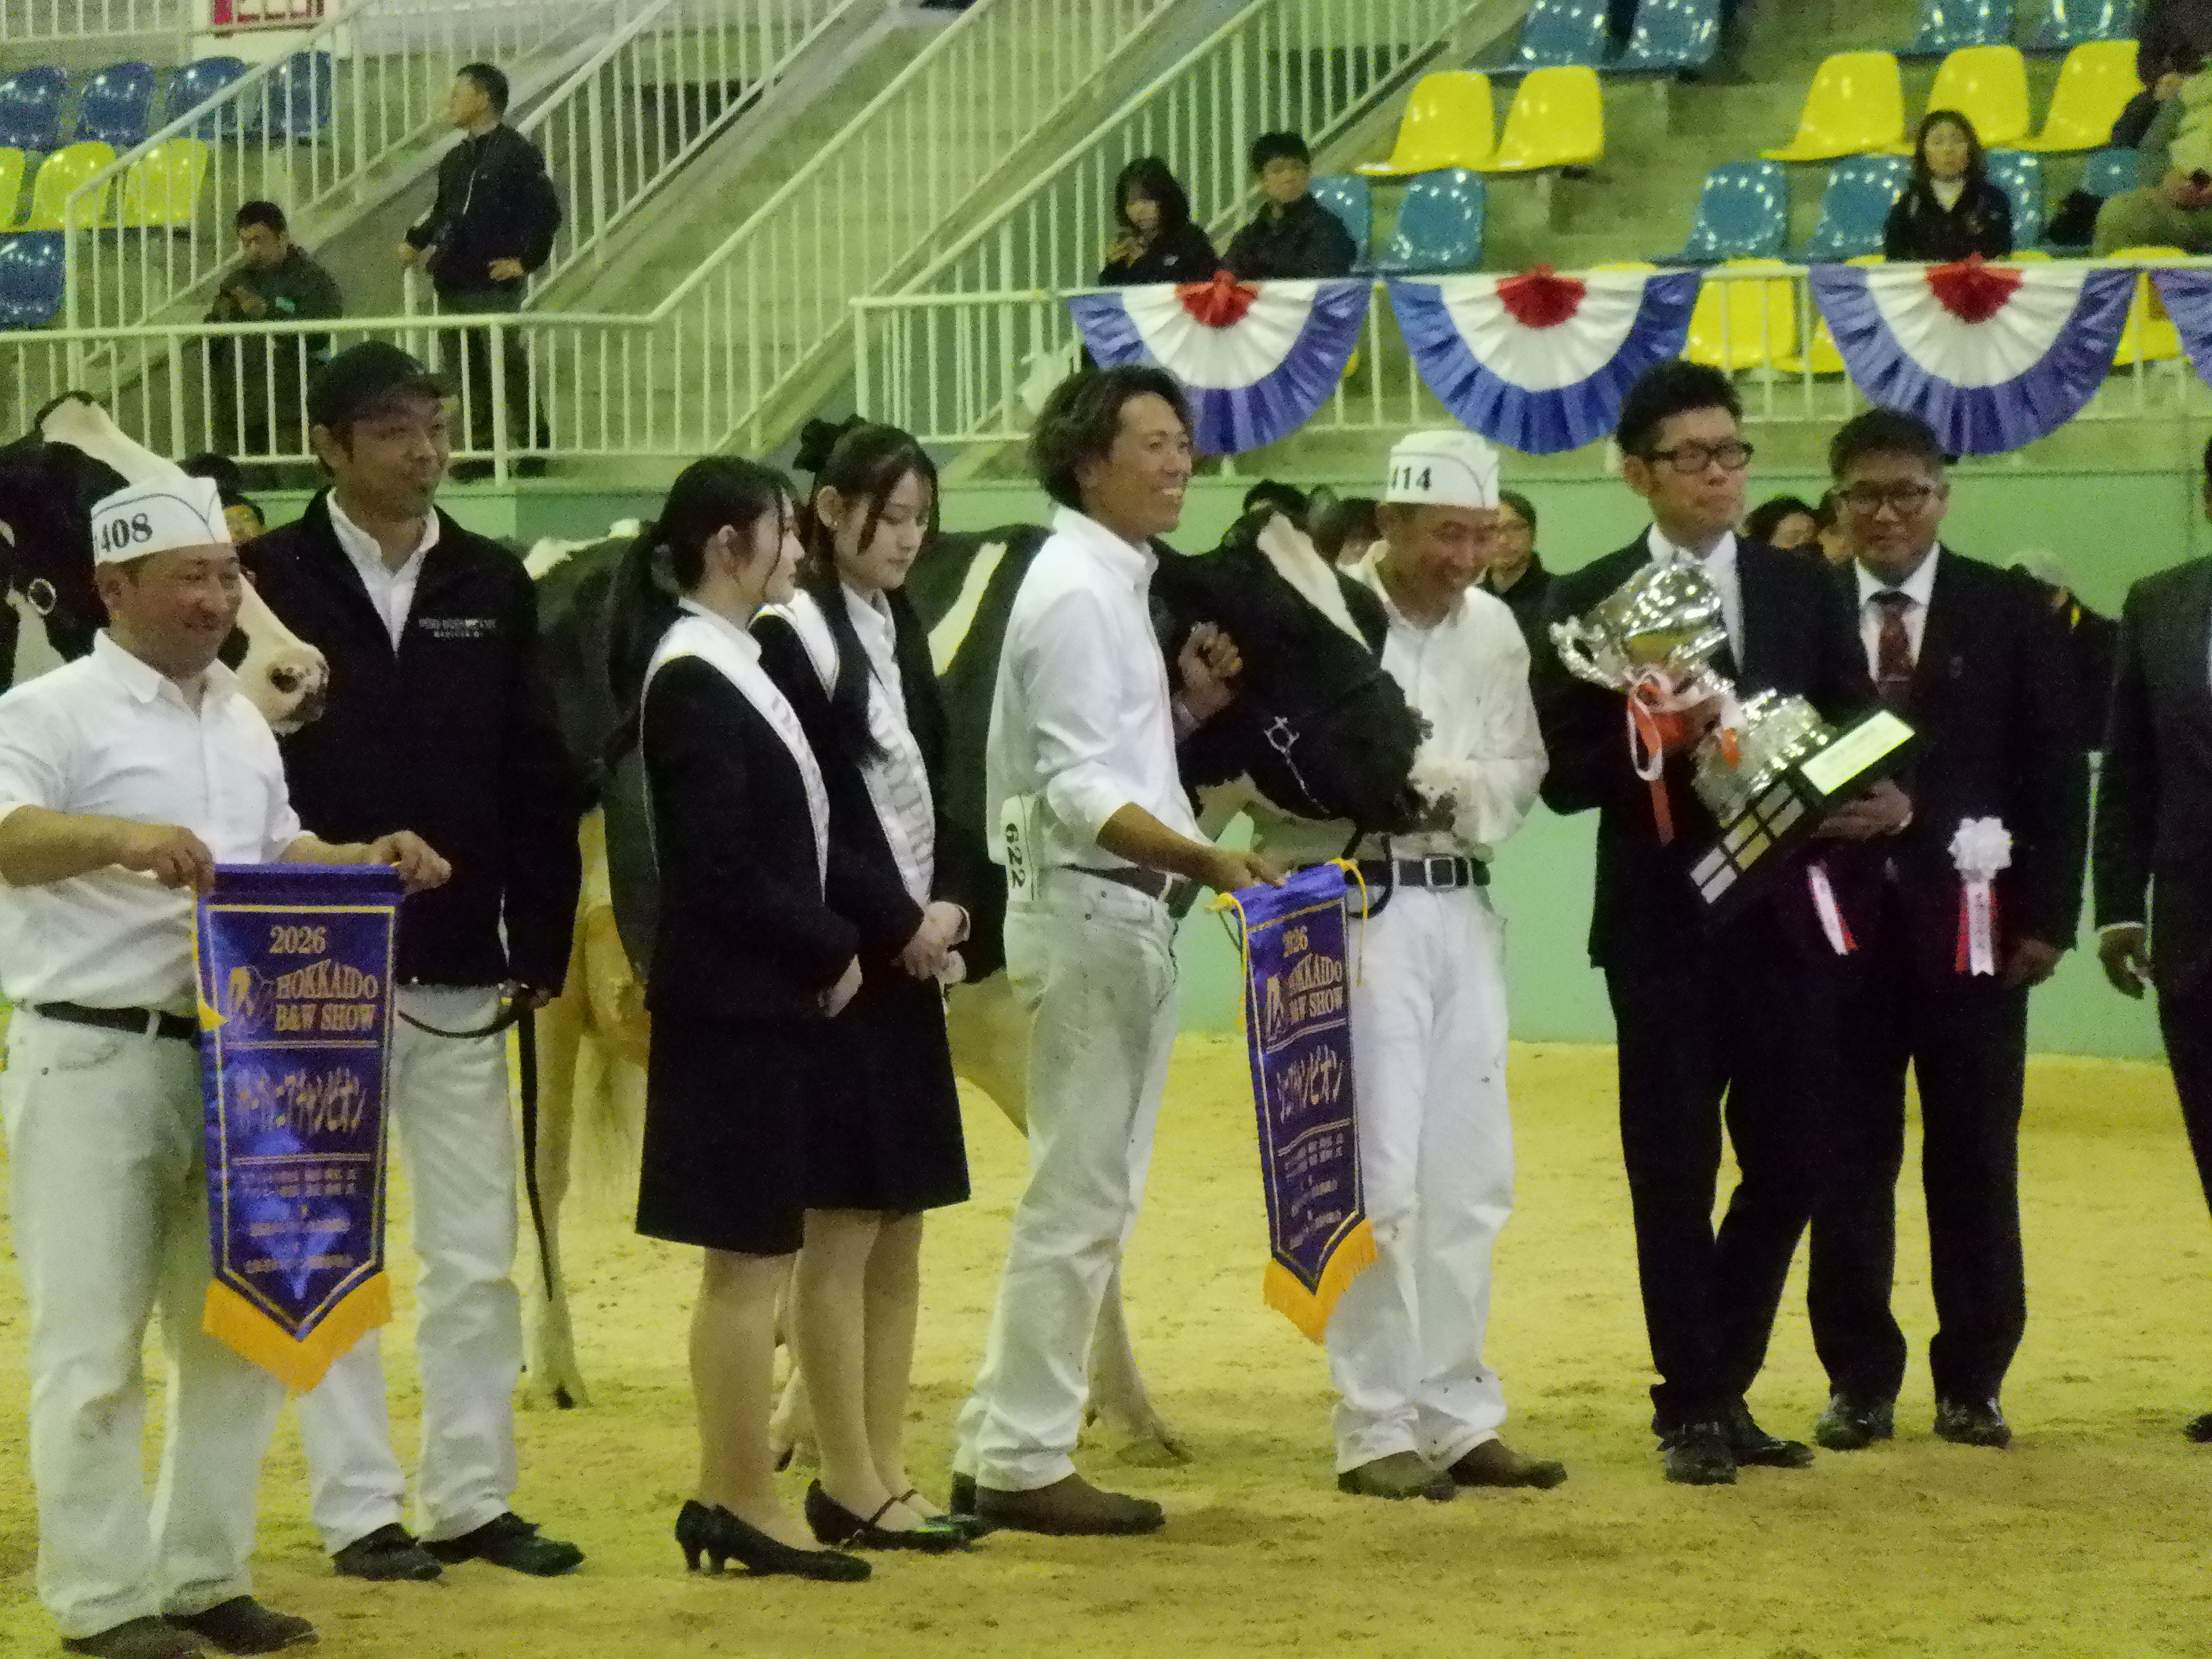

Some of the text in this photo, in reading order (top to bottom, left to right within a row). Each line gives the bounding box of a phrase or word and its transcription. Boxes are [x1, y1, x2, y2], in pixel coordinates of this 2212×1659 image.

[1392, 466, 1431, 491] 114
[101, 513, 153, 553] 408
[1005, 822, 1026, 889] 622
[269, 926, 326, 954] 2026
[276, 958, 378, 999] HOKKAIDO
[320, 1003, 376, 1032] SHOW
[1309, 986, 1343, 1018] SHOW
